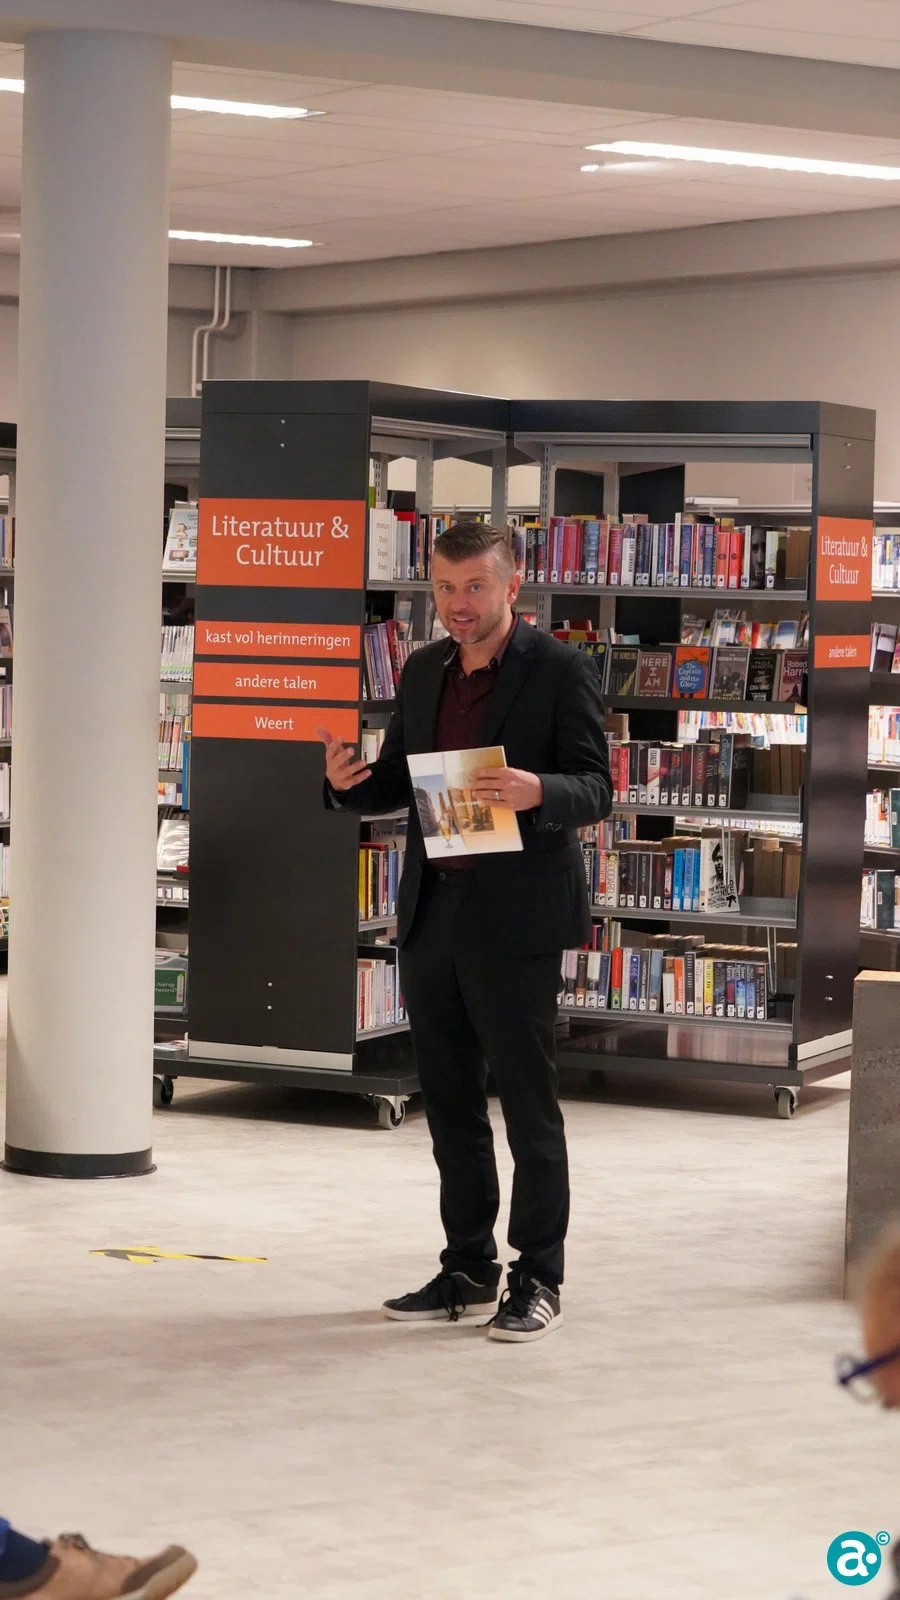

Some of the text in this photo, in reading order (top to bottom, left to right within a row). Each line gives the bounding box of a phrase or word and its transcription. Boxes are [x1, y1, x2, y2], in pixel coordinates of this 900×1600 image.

[212, 515, 325, 538] Literatuur
[331, 515, 349, 539] &
[821, 535, 868, 558] Literatuur &
[236, 543, 324, 567] Cultuur
[829, 563, 859, 585] Cultuur
[206, 629, 351, 650] kast vol herinneringen
[828, 644, 857, 658] andere talen
[641, 657, 668, 667] HERE
[787, 660, 808, 668] Robert
[650, 667, 657, 677] I
[235, 674, 317, 690] andere talen
[644, 677, 661, 687] AM
[254, 716, 294, 731] Weert
[606, 860, 616, 893] GODDARD
